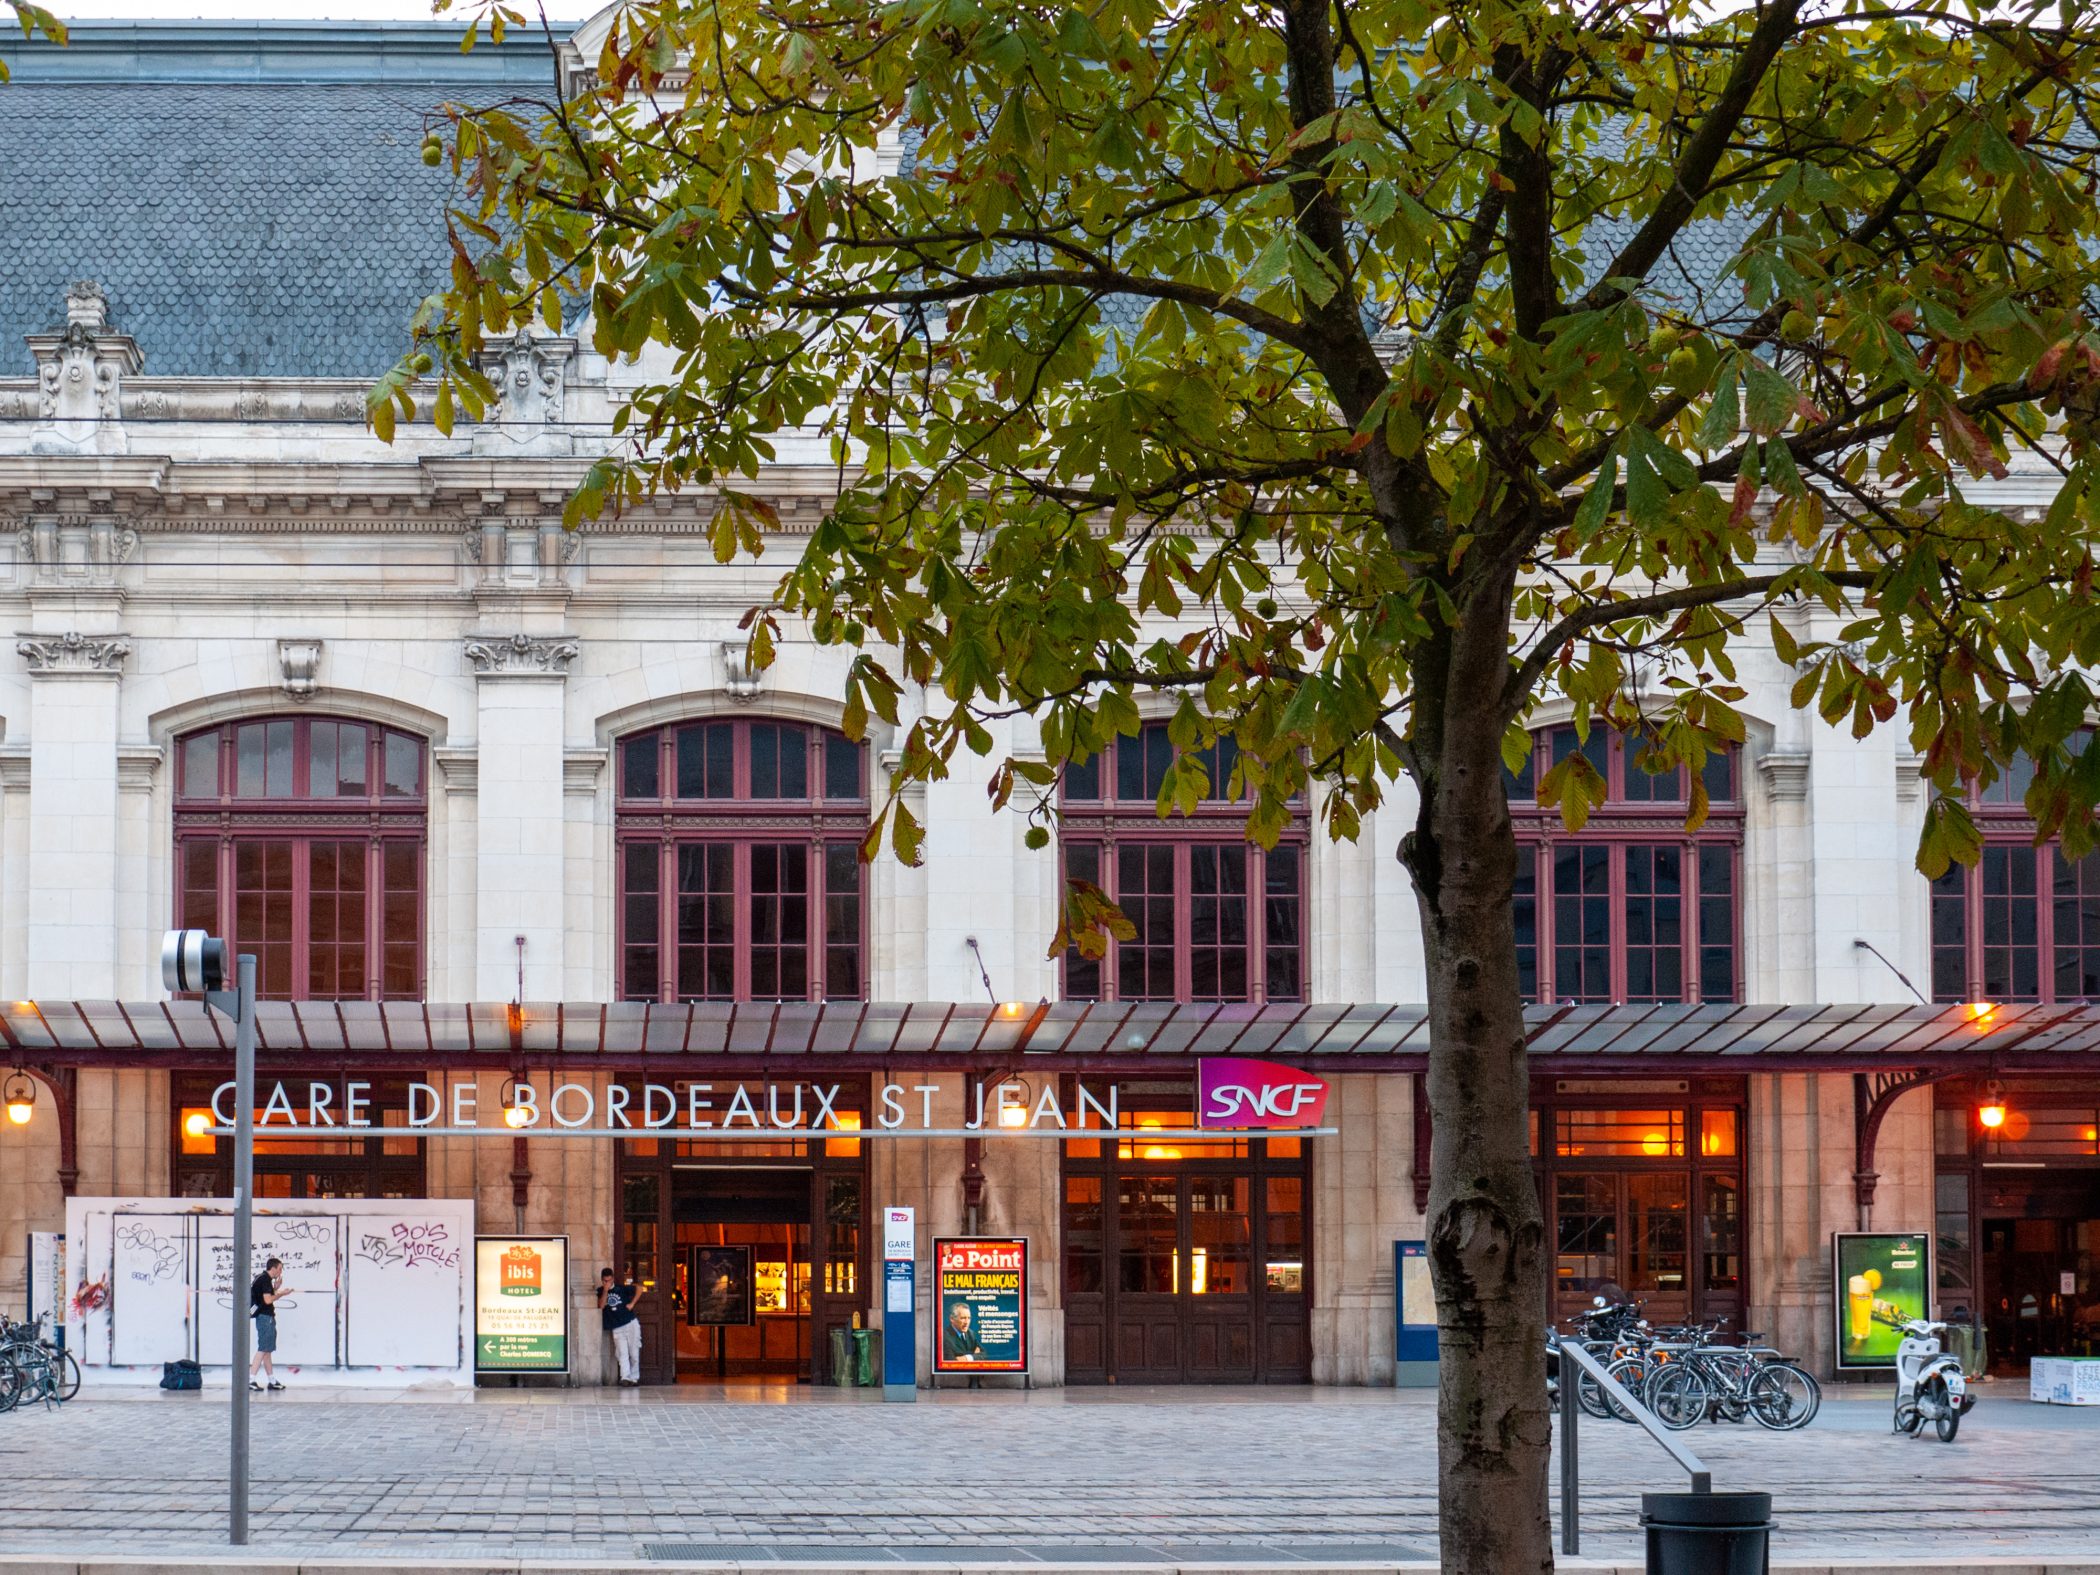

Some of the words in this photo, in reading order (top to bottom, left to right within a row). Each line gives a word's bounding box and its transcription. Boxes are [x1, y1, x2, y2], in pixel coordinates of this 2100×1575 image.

[408, 1083, 477, 1126] DE
[514, 1083, 841, 1129] BORDEAUX
[878, 1083, 940, 1129] ST
[966, 1083, 1118, 1130] JEAN
[1206, 1083, 1323, 1118] SNCF
[942, 1254, 964, 1268] Le
[967, 1249, 1021, 1268] Point
[507, 1264, 535, 1279] ibis
[944, 1274, 954, 1288] LE
[955, 1274, 974, 1288] MAL
[975, 1273, 1019, 1290] FRANÇAIS
[507, 1287, 535, 1295] HOTEL
